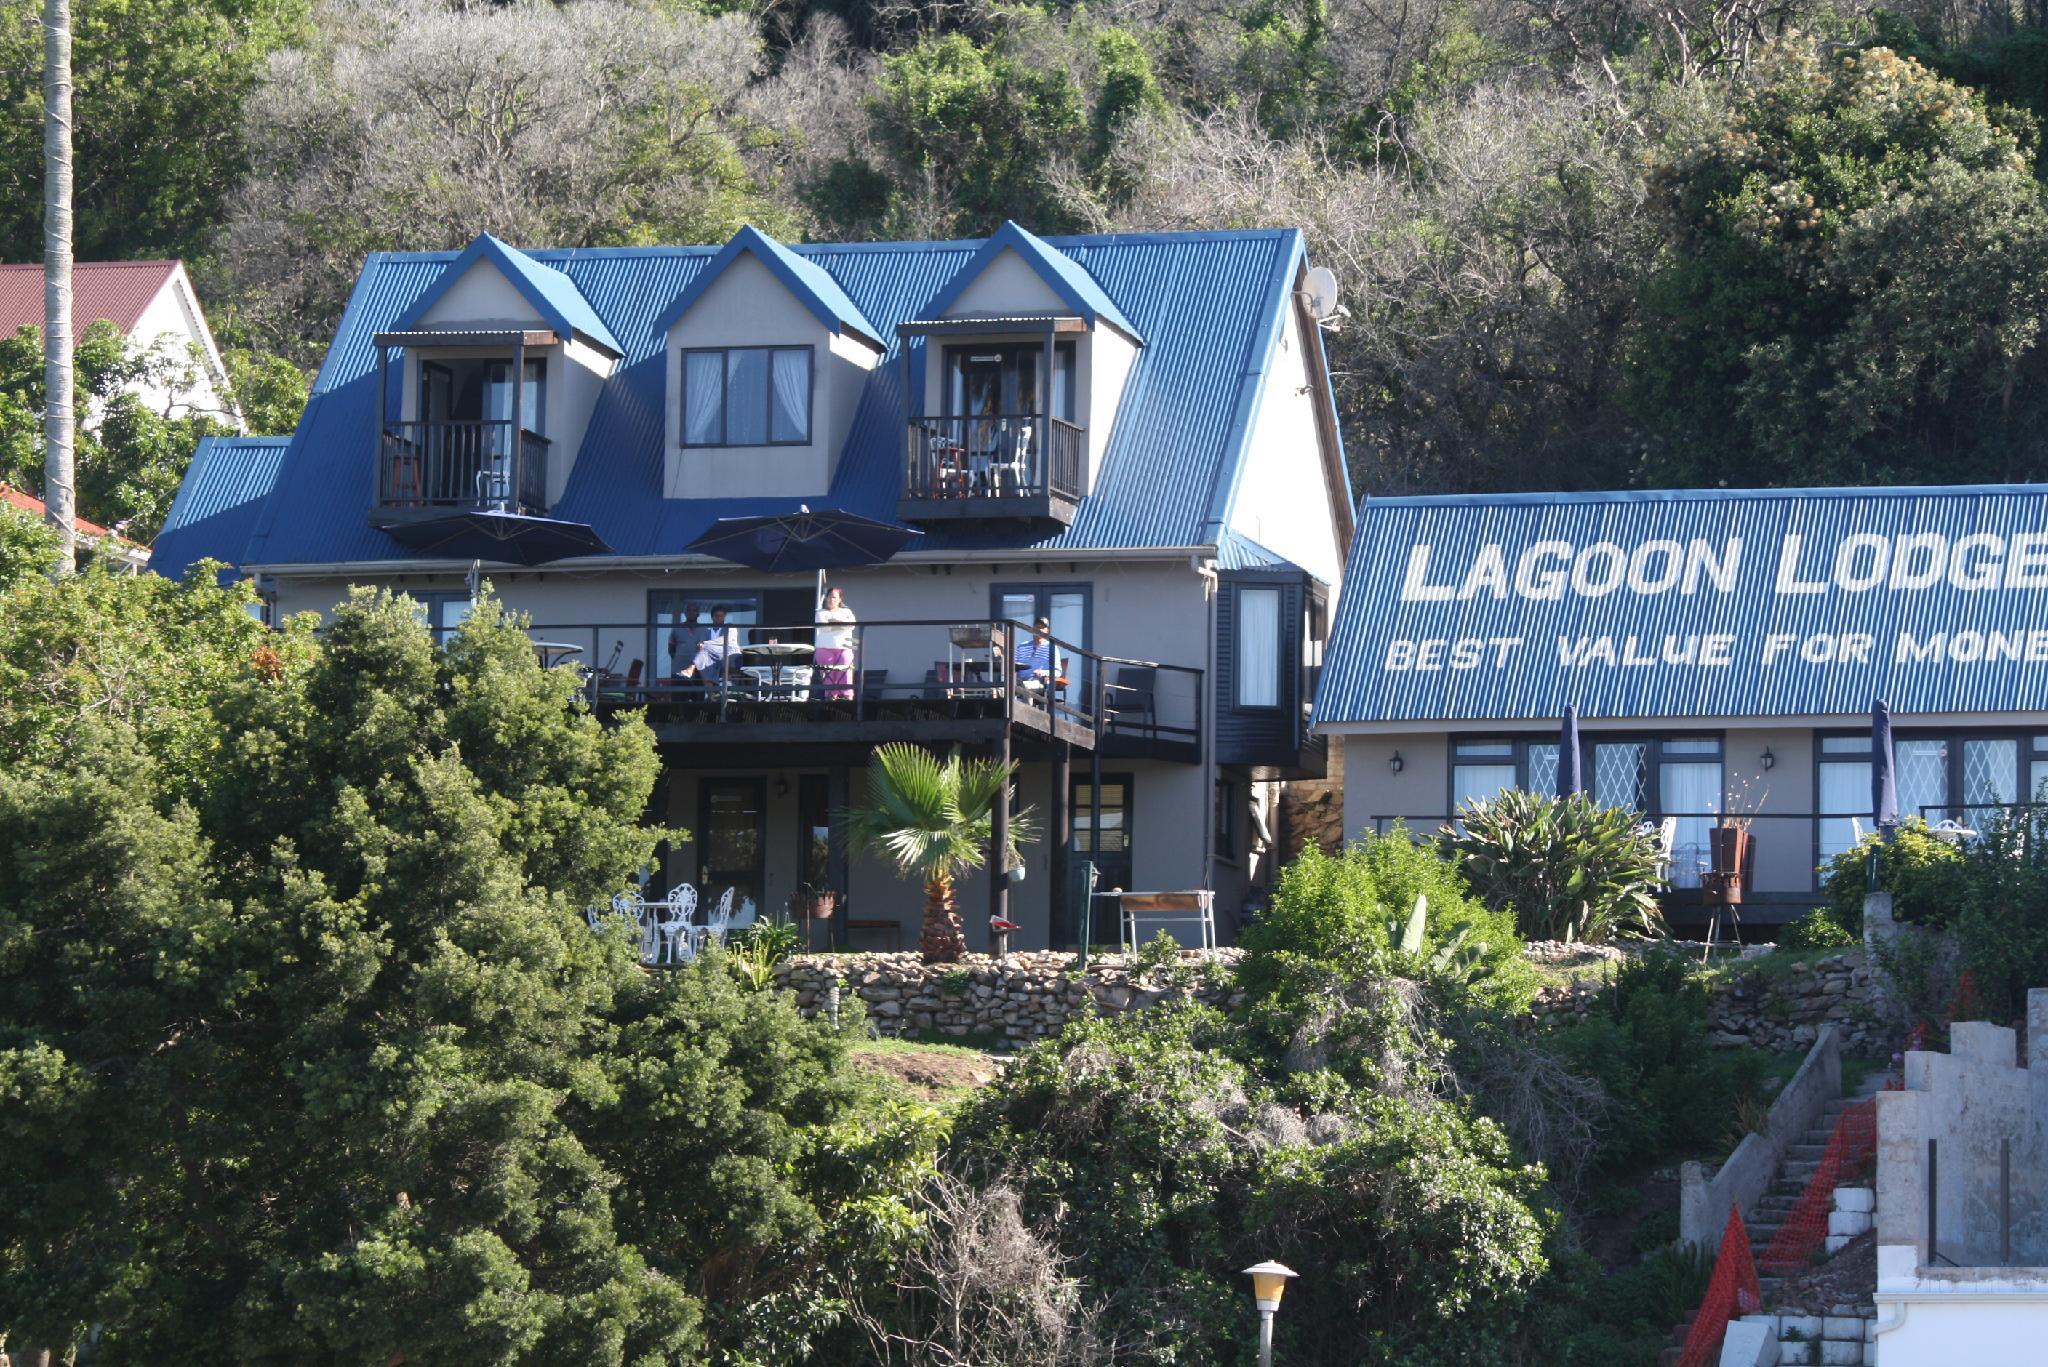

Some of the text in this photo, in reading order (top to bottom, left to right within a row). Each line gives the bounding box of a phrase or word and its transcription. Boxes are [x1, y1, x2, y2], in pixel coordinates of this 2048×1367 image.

[1400, 532, 2048, 601] LAGOON LODGE
[1384, 637, 1522, 671] BEST
[1557, 633, 1736, 668] VALUE
[1761, 632, 1875, 665] FOR
